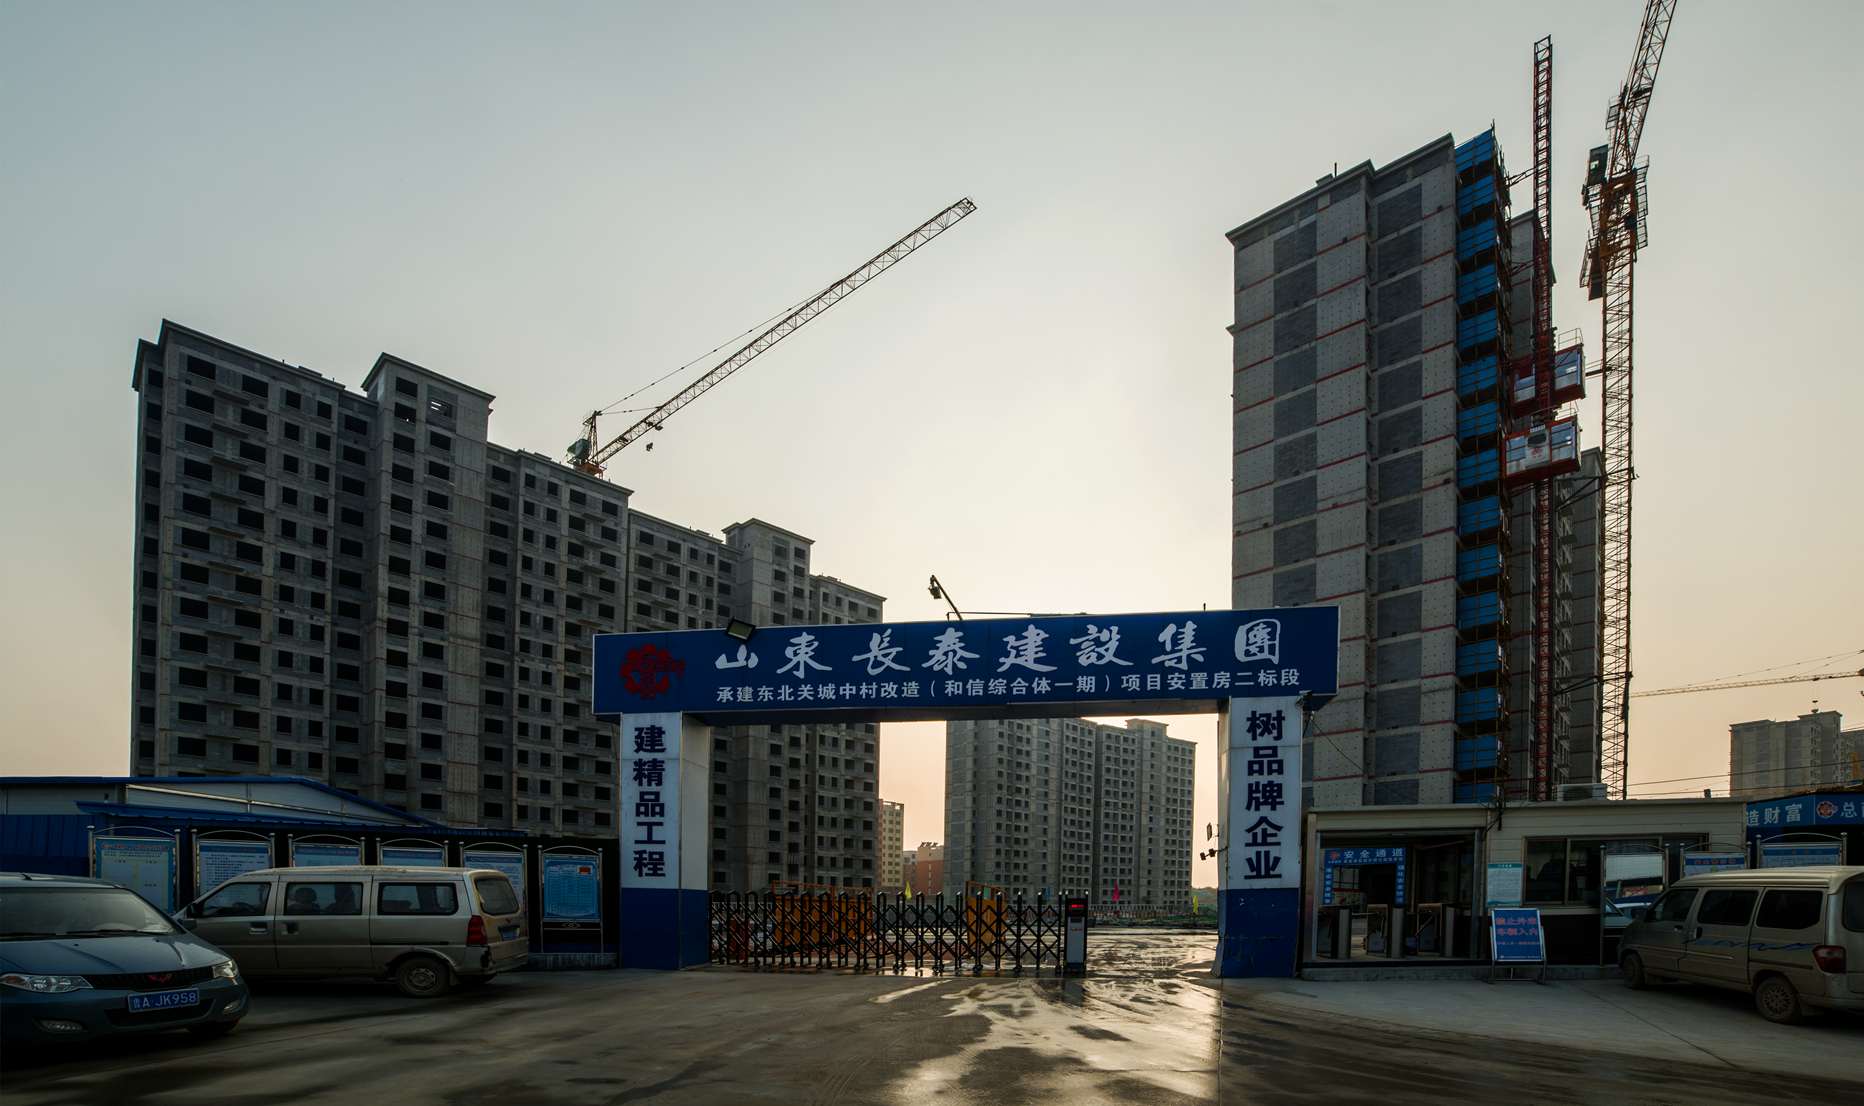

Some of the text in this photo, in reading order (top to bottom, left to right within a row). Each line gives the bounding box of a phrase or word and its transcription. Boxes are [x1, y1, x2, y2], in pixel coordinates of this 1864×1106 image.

[715, 618, 1281, 680] 山東長泰建設集團
[633, 725, 667, 878] 建精品工程
[1243, 709, 1286, 880] 树品牌企业
[1343, 848, 1404, 859] 安全通道
[155, 993, 197, 1006] JK958
